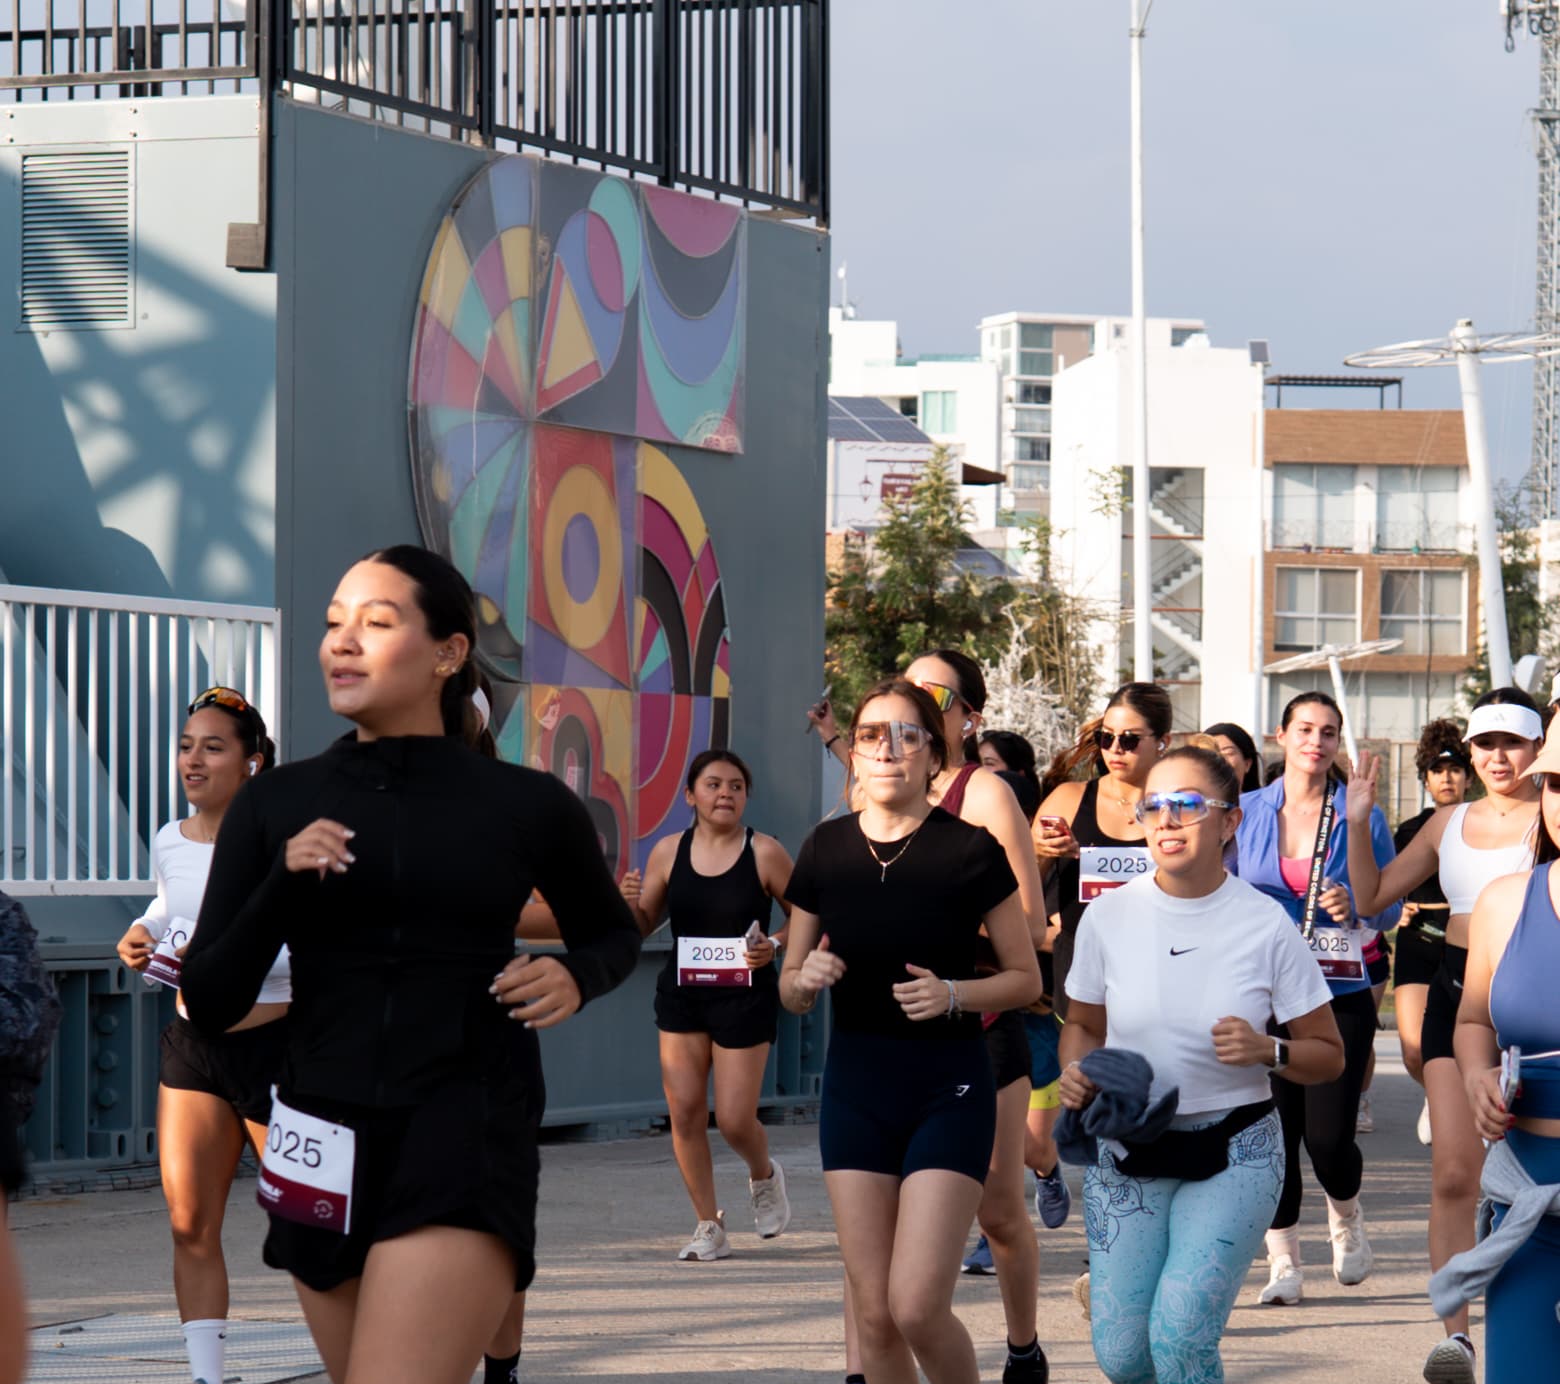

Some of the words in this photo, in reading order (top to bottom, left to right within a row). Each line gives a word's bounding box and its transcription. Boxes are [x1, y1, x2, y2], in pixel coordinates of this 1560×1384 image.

[1097, 856, 1148, 873] 2025
[1309, 936, 1350, 953] 2025
[691, 946, 736, 961] 2025
[267, 1122, 322, 1169] 025
